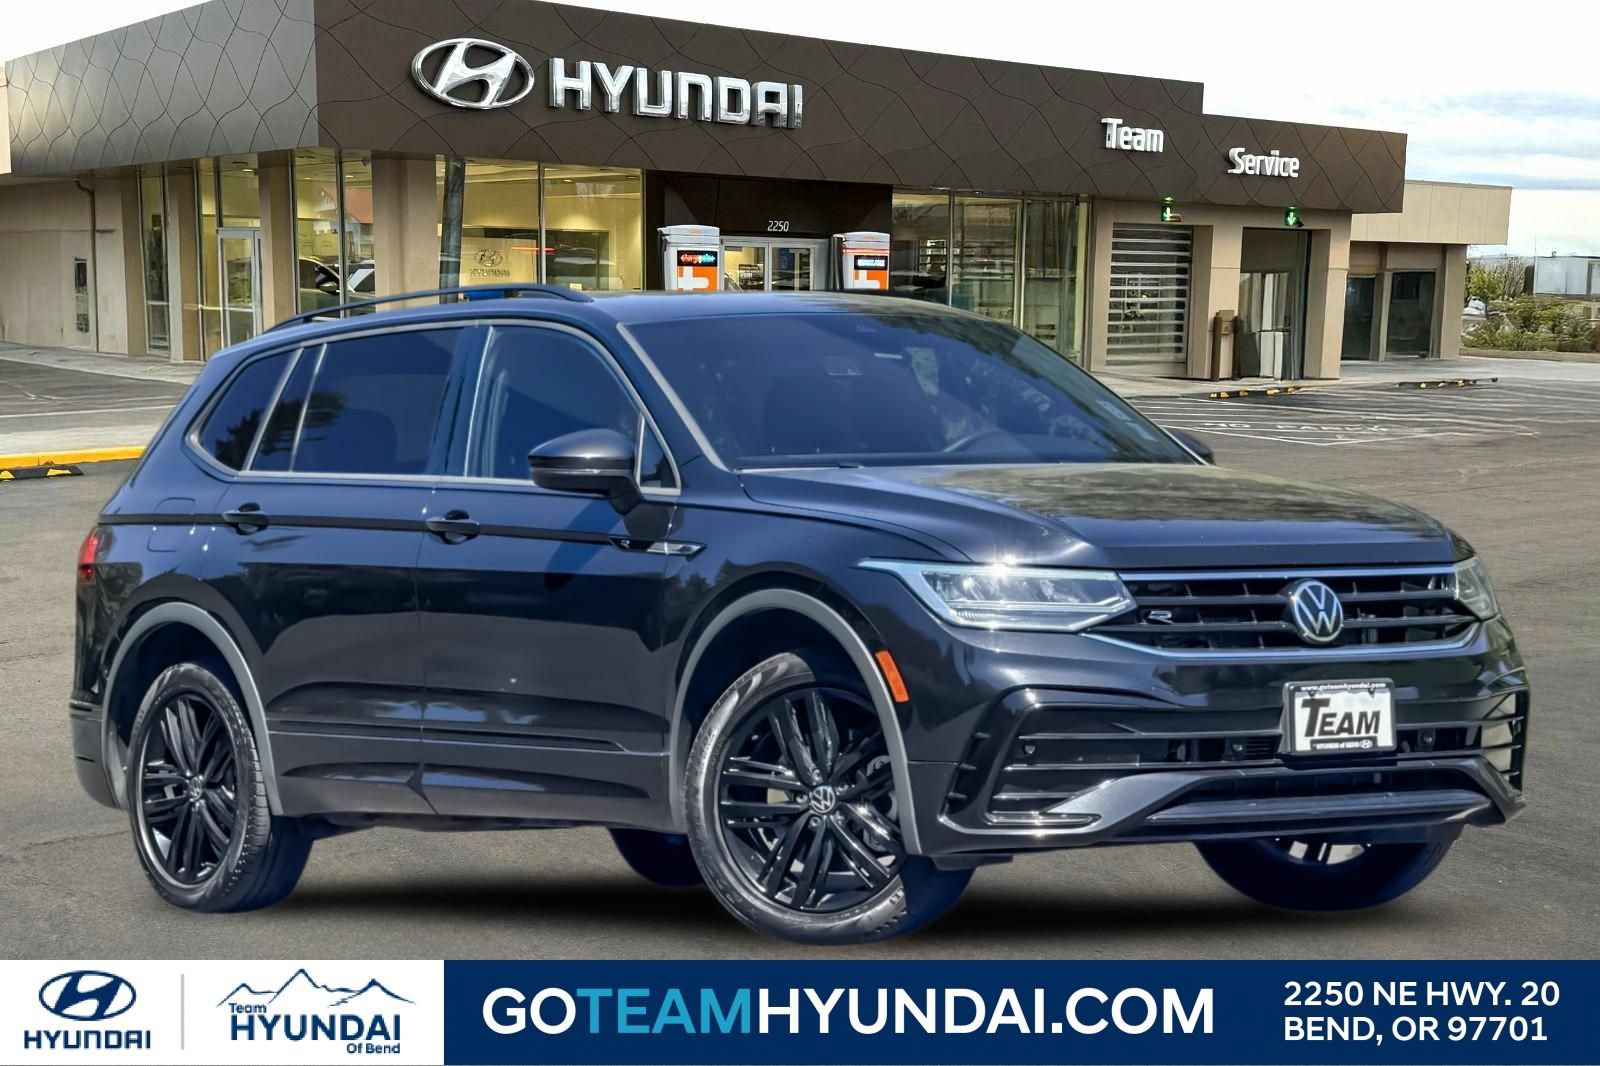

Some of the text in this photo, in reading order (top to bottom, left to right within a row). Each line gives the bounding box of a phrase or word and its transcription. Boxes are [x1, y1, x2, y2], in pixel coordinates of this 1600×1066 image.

[548, 57, 803, 129] HYUNDAI
[1101, 117, 1164, 153] Team
[1227, 147, 1300, 178] Service
[767, 220, 790, 232] 2250
[1301, 698, 1381, 737] TEAM
